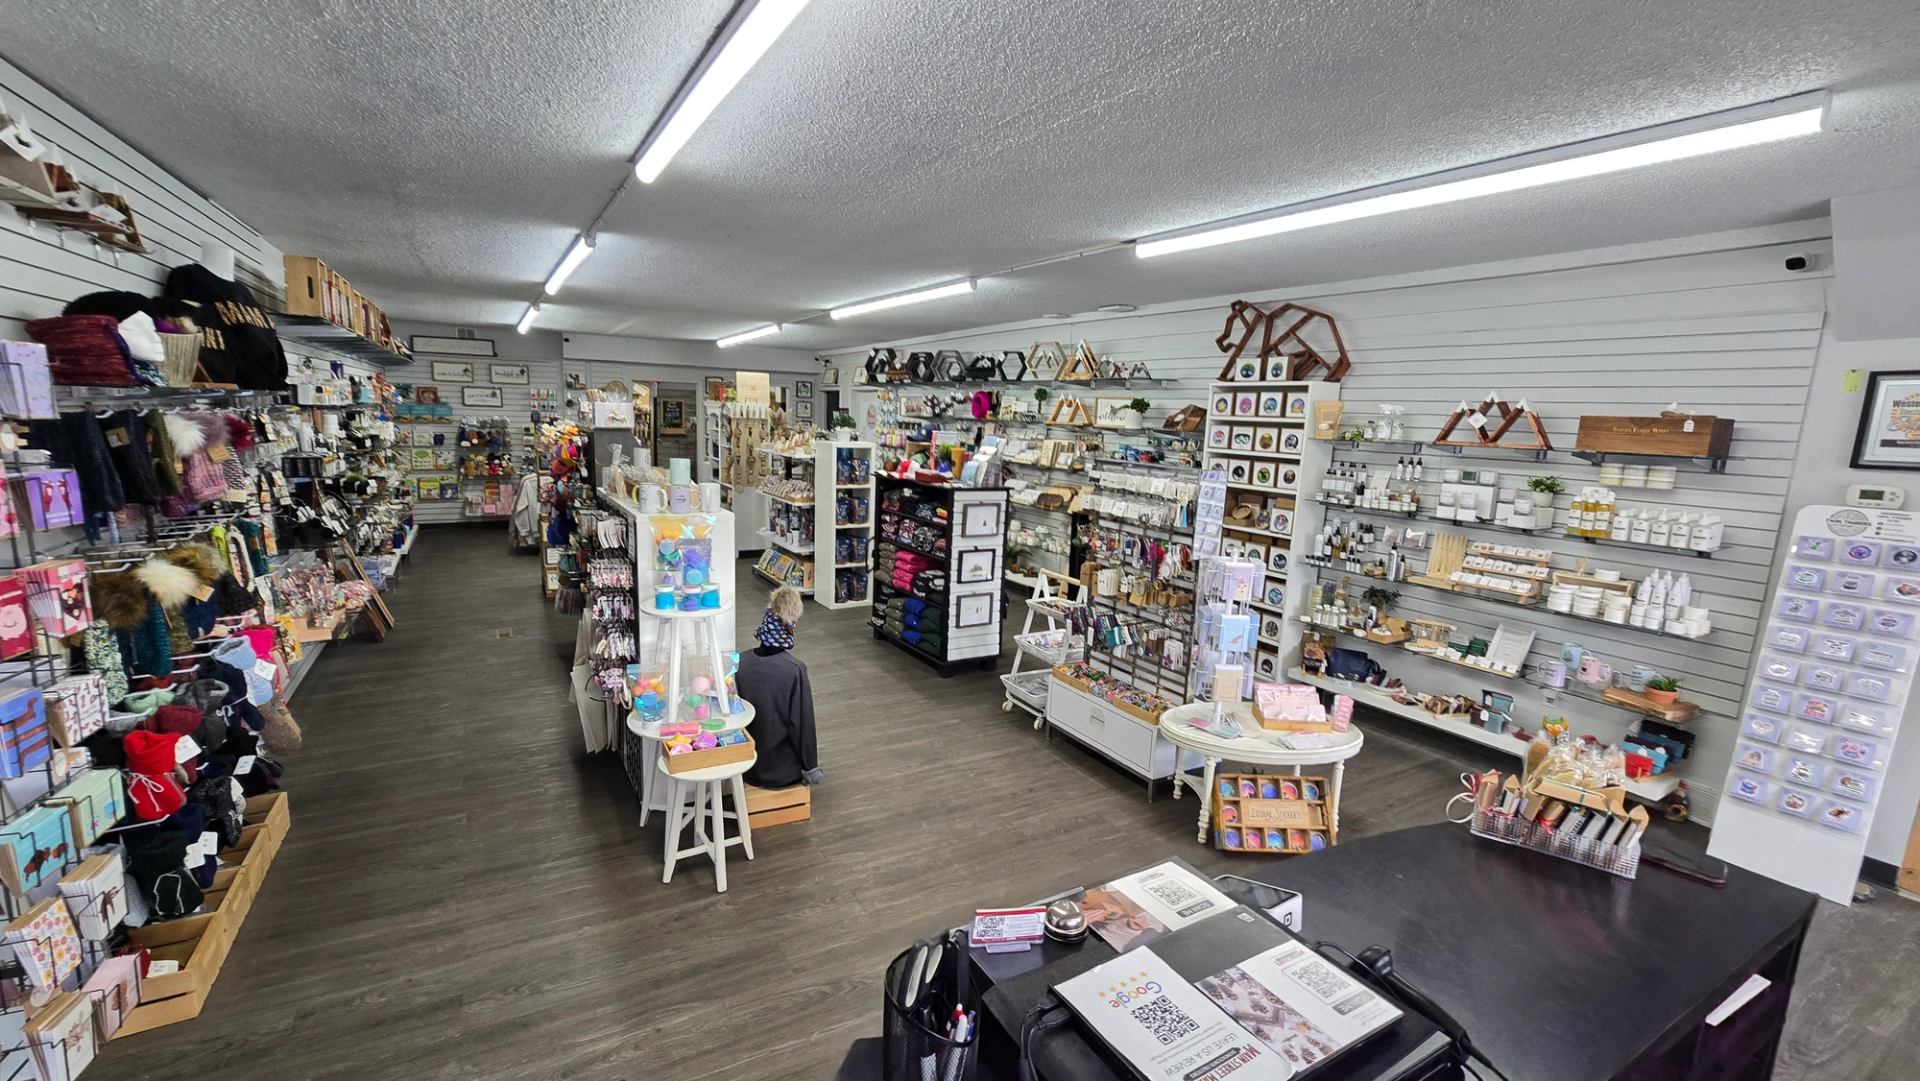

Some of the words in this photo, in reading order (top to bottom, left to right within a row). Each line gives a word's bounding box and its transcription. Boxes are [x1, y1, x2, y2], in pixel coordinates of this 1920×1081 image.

[1109, 980, 1163, 1009] Google
[1200, 1045, 1216, 1057] US
[1211, 1032, 1240, 1051] LEAVE
[1194, 1051, 1203, 1060] A
[1237, 1043, 1262, 1065] MAIN
[1165, 1055, 1198, 1078] REVIEW
[1215, 1056, 1244, 1079] STREET
